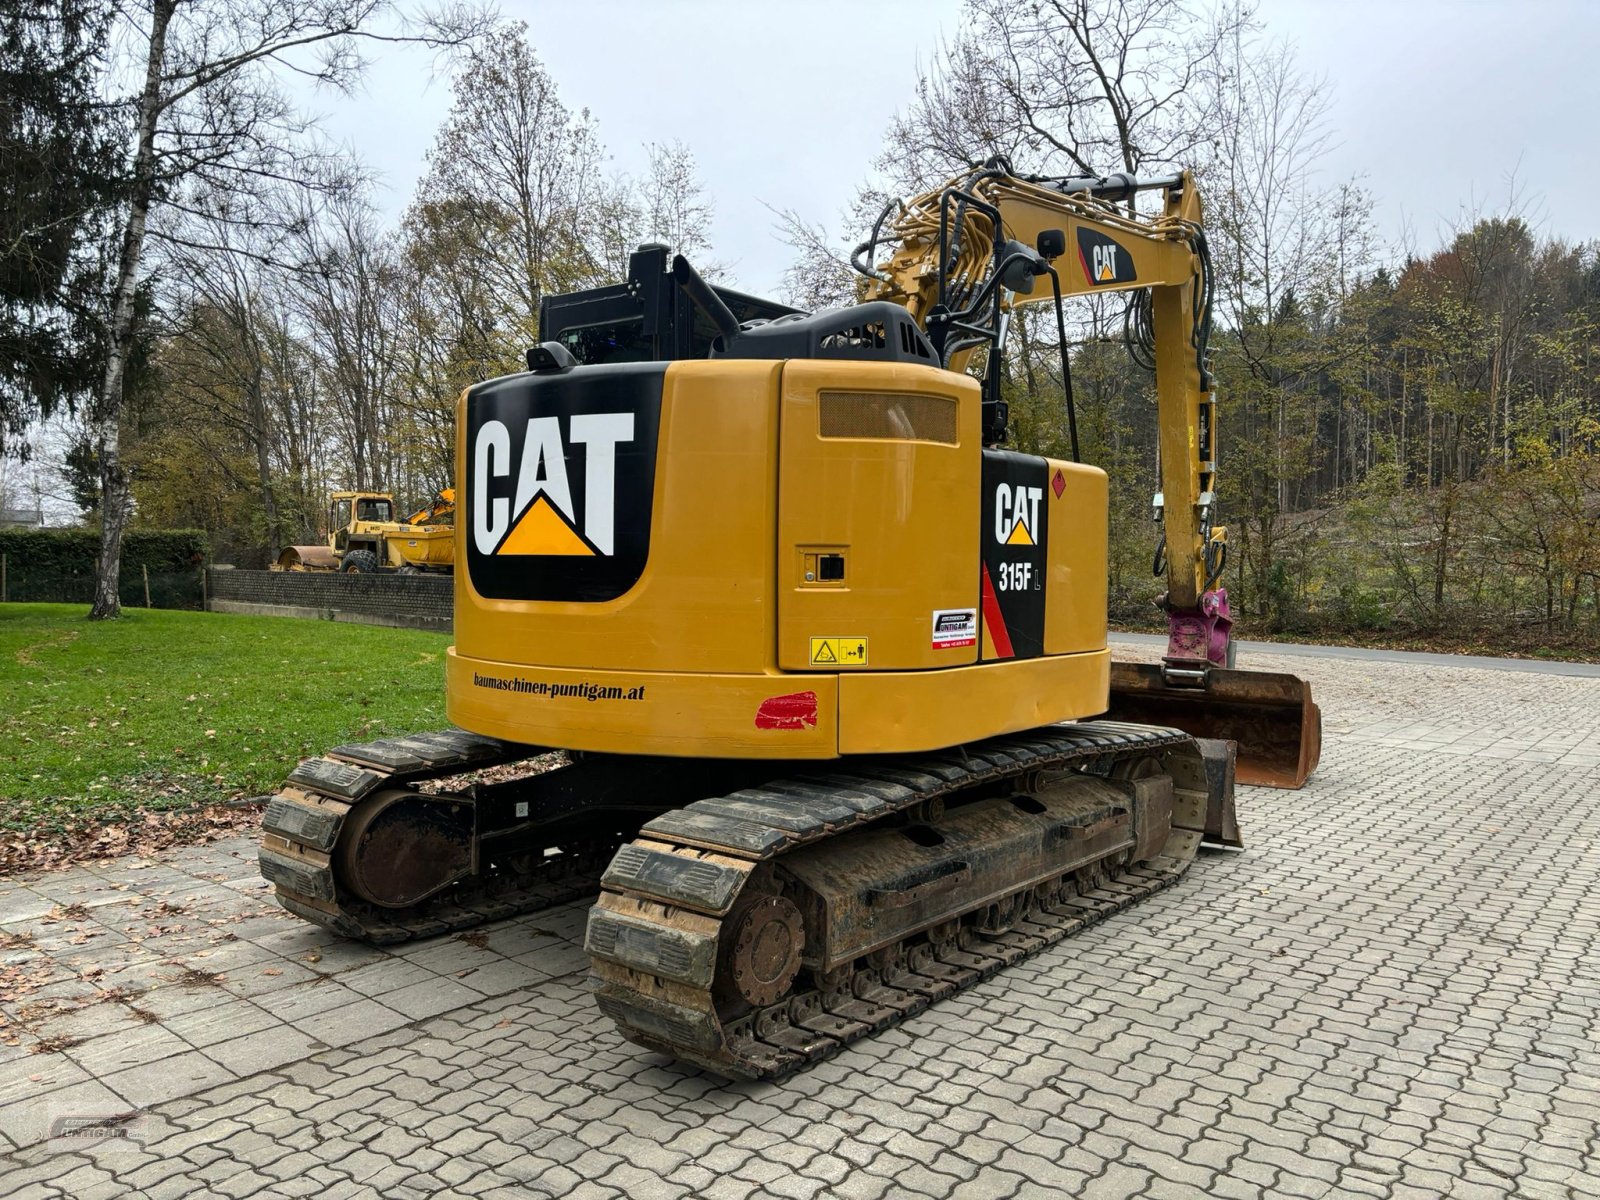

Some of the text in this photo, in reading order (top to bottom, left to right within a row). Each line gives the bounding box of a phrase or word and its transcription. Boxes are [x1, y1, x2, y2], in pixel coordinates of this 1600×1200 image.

[1093, 245, 1117, 281] CAT
[474, 413, 635, 556] CAT
[995, 483, 1043, 545] CAT
[999, 562, 1031, 592] 315F
[474, 672, 645, 701] baumaschinen-puntigam.at
